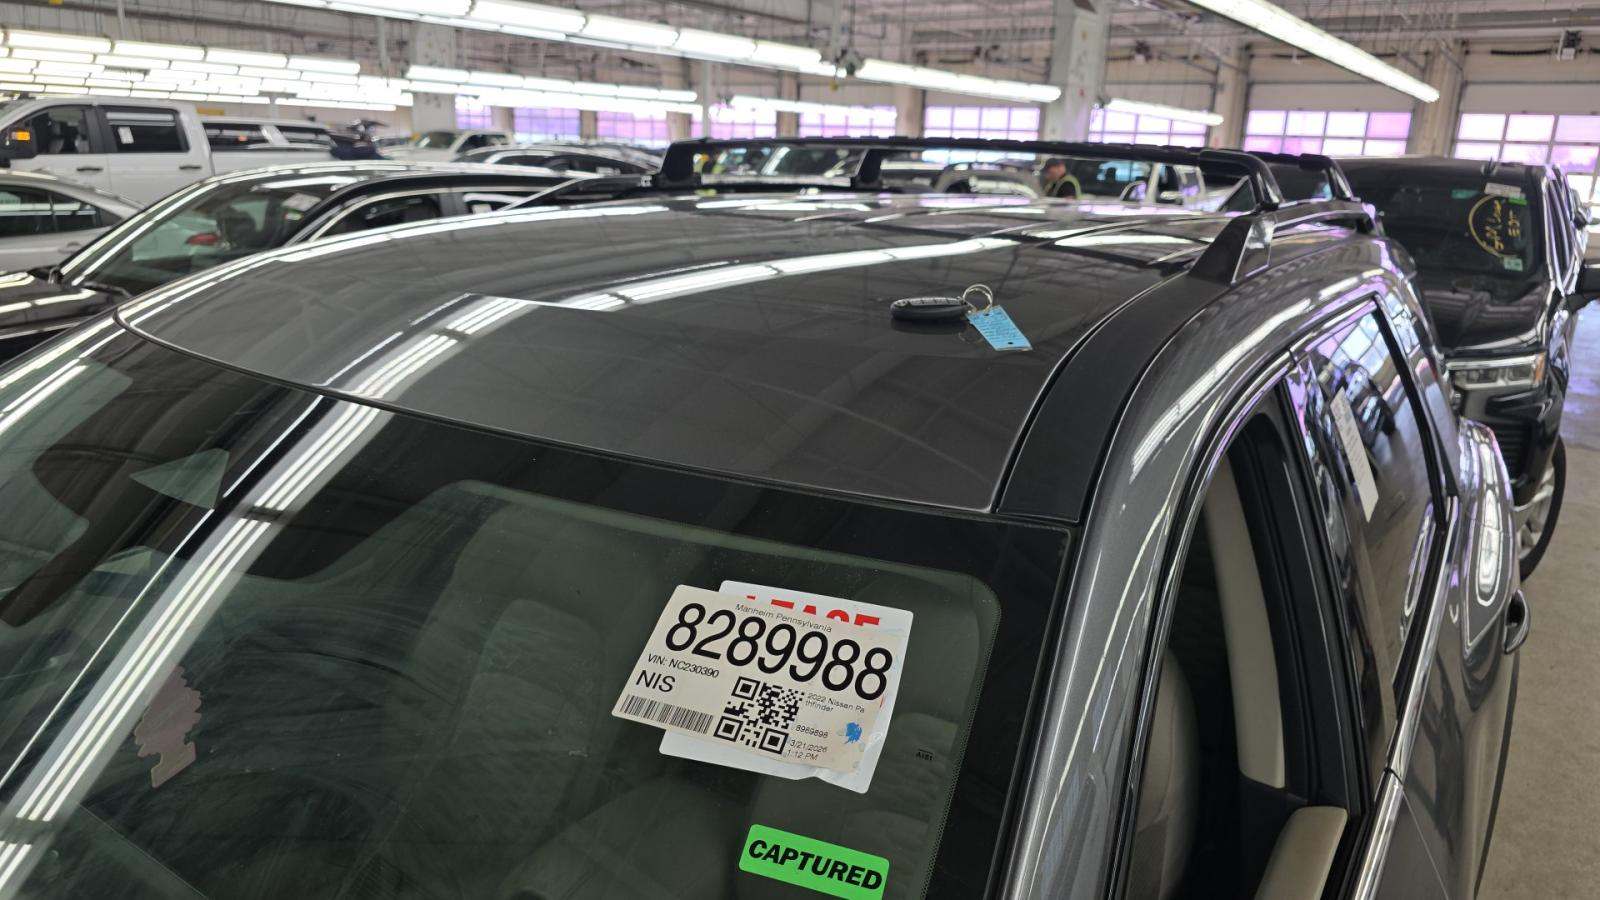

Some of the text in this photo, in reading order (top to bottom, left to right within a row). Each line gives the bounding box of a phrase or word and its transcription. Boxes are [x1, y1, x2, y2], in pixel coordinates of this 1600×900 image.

[735, 603, 774, 618] Manheim
[775, 611, 833, 633] Pennsylvania
[665, 602, 893, 700] 8289988
[647, 653, 720, 679] VIN: NC230390
[635, 669, 676, 693] NIS
[807, 692, 827, 702] 2022
[855, 704, 865, 714] Pa
[804, 752, 819, 761] PM
[748, 839, 883, 890] CAPTURED
